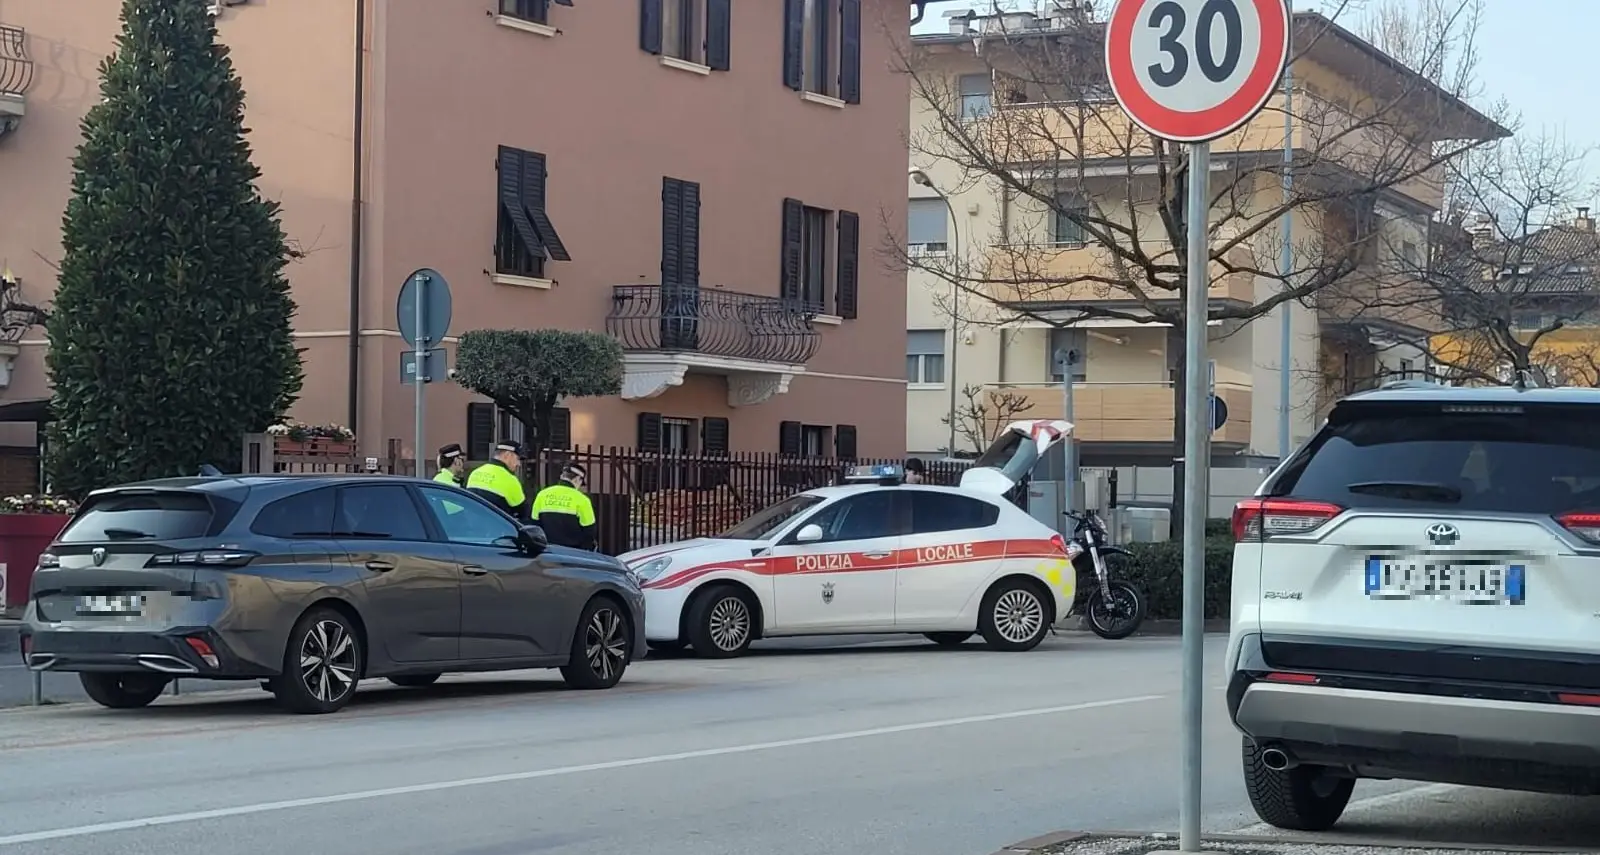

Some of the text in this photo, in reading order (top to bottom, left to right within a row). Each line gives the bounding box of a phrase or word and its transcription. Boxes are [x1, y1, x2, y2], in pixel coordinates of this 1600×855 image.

[1147, 0, 1243, 88] 30
[796, 544, 974, 570] POLIZIA LOCALE
